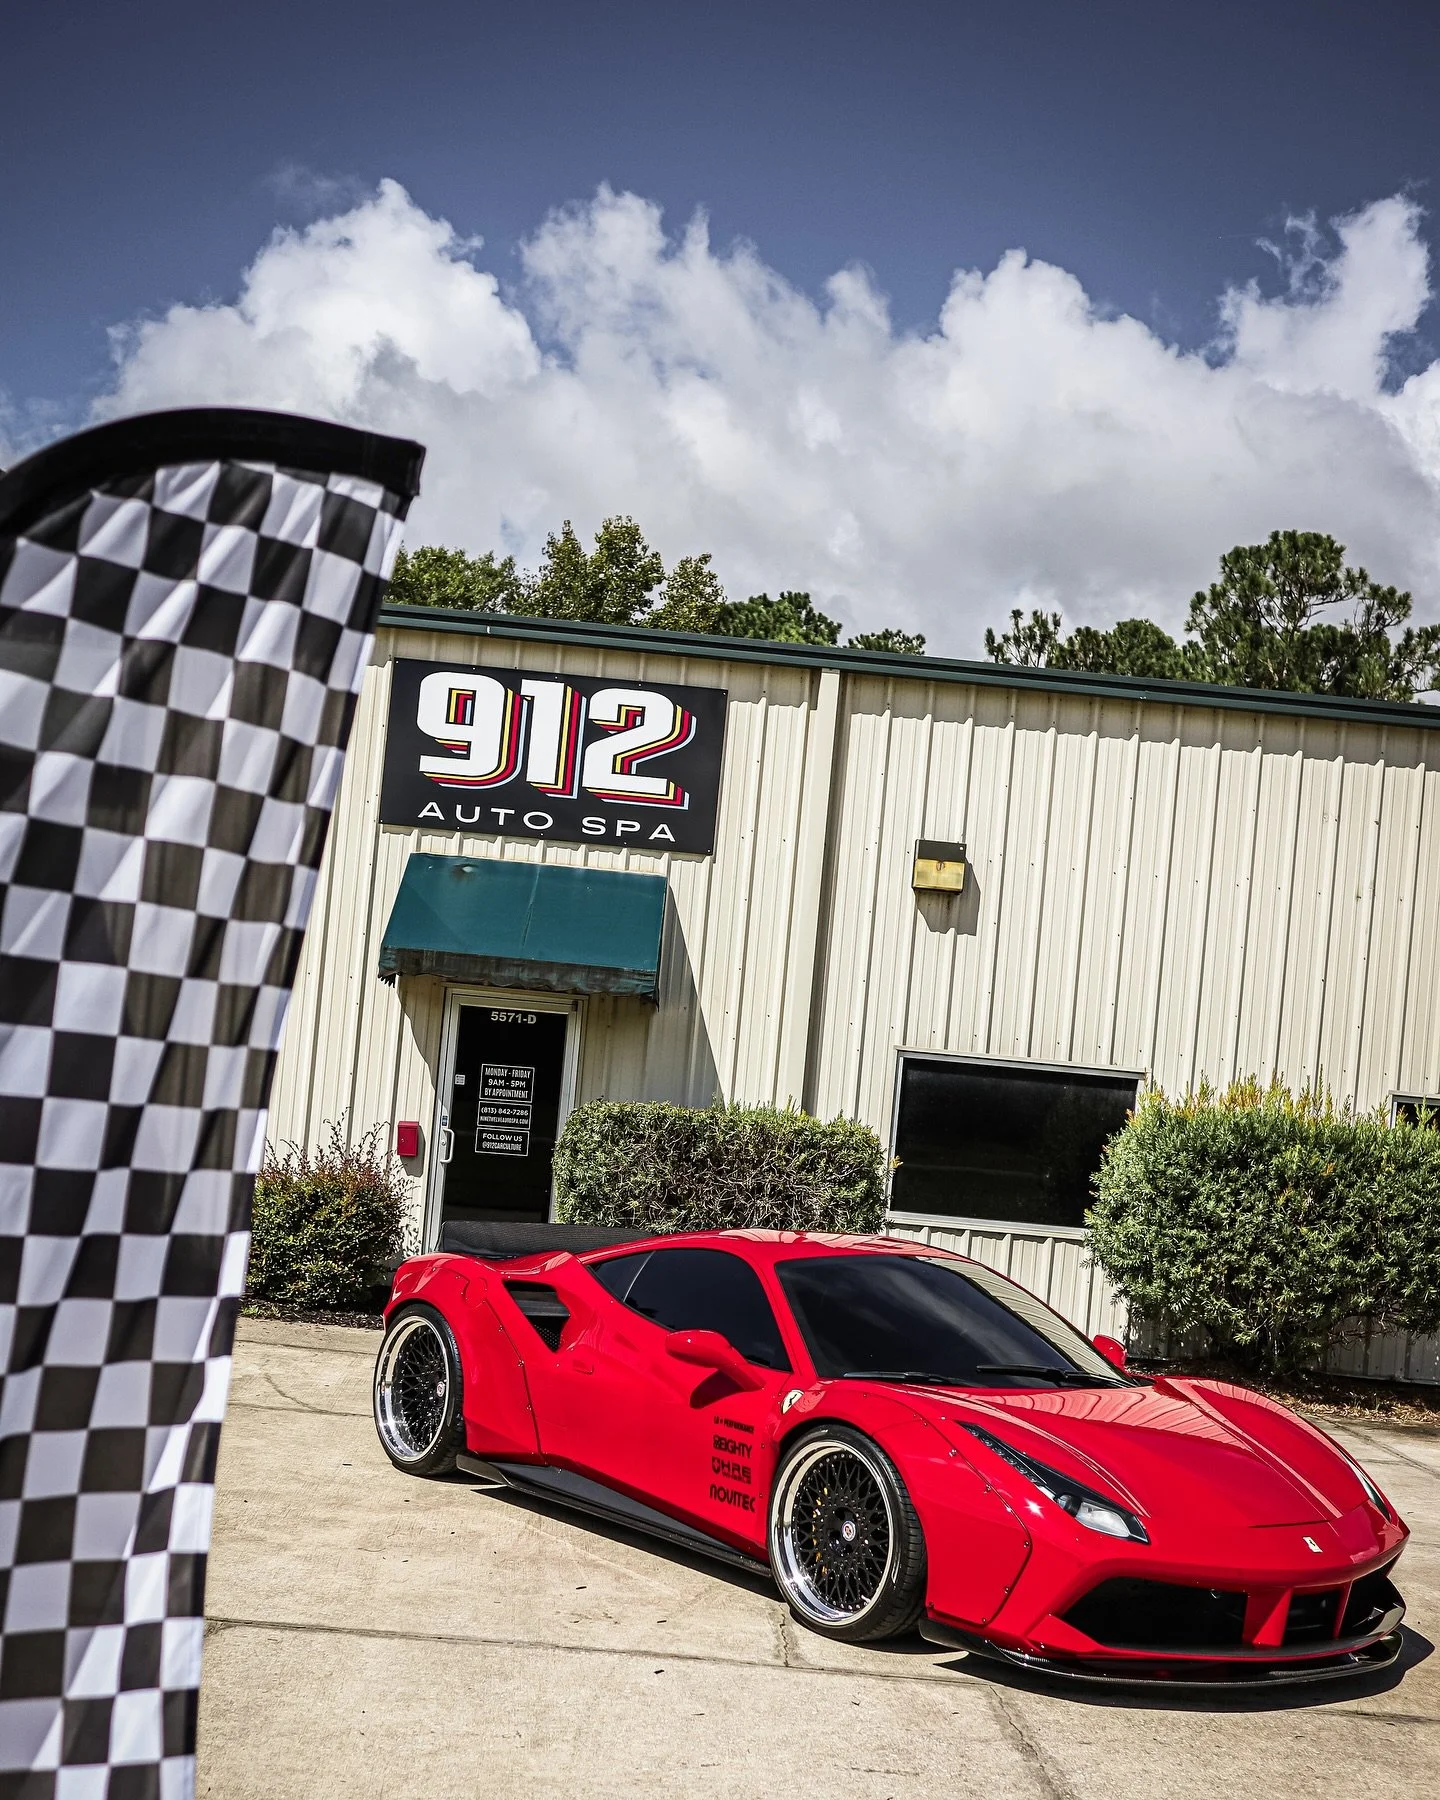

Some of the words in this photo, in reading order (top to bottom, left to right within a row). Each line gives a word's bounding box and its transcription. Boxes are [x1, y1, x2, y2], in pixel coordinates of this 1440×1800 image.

[416, 671, 697, 810] 912
[417, 801, 554, 830] AUTO
[581, 816, 676, 842] SPA
[491, 1011, 537, 1024] 5571-D
[485, 1067, 508, 1077] MONDAY
[512, 1069, 532, 1079] FRIDAY
[488, 1078, 505, 1087] 9AM
[510, 1080, 526, 1088] 5PM
[484, 1088, 492, 1096] BY
[492, 1088, 529, 1099] APPOINTMENT
[482, 1133, 513, 1141] FOLLOW
[721, 1459, 752, 1478] HRE
